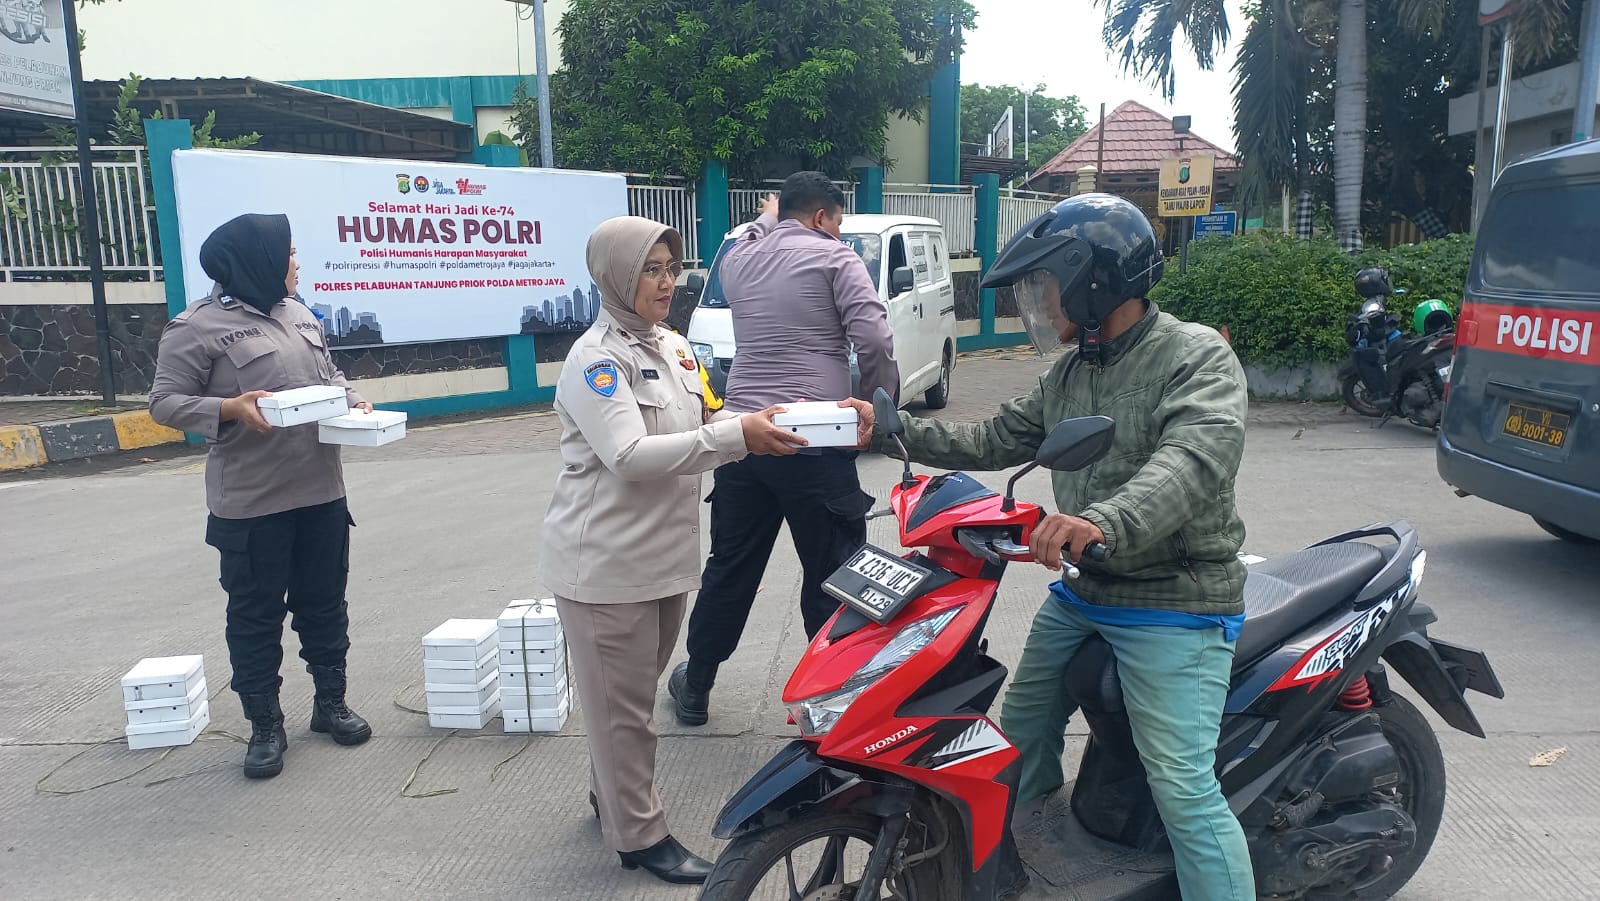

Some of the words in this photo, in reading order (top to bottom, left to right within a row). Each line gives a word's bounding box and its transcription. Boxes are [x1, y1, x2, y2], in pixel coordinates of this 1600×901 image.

[368, 202, 422, 214] Selamat
[425, 204, 451, 215] Hari
[454, 205, 478, 216] Jadi
[482, 205, 515, 216] Ke-74
[1190, 199, 1206, 210] LAPOR
[337, 215, 458, 244] HUMAS
[463, 218, 542, 245] POLRI
[360, 248, 388, 258] Polisi
[389, 248, 433, 258] Humanis
[434, 249, 475, 260] Harapan
[475, 249, 528, 260] Masyarakat
[325, 260, 380, 271] #polripresisi
[384, 260, 437, 271] #humaspolri
[439, 260, 506, 271] #poldametrojaya
[508, 259, 556, 270] #jagajakarta+
[314, 282, 353, 292] POLRES
[354, 281, 413, 291] PELABUHAN
[414, 280, 458, 290] TANJUNG
[460, 279, 486, 289] PRIOK
[487, 279, 515, 288] POLDA
[516, 278, 543, 287] METRO
[544, 278, 566, 287] JAYA
[220, 326, 263, 346] IVONE
[1497, 314, 1593, 356] POLISI
[849, 552, 866, 568] B
[859, 557, 893, 581] 4336
[886, 569, 919, 593] UCX
[863, 724, 919, 755] HONDA
